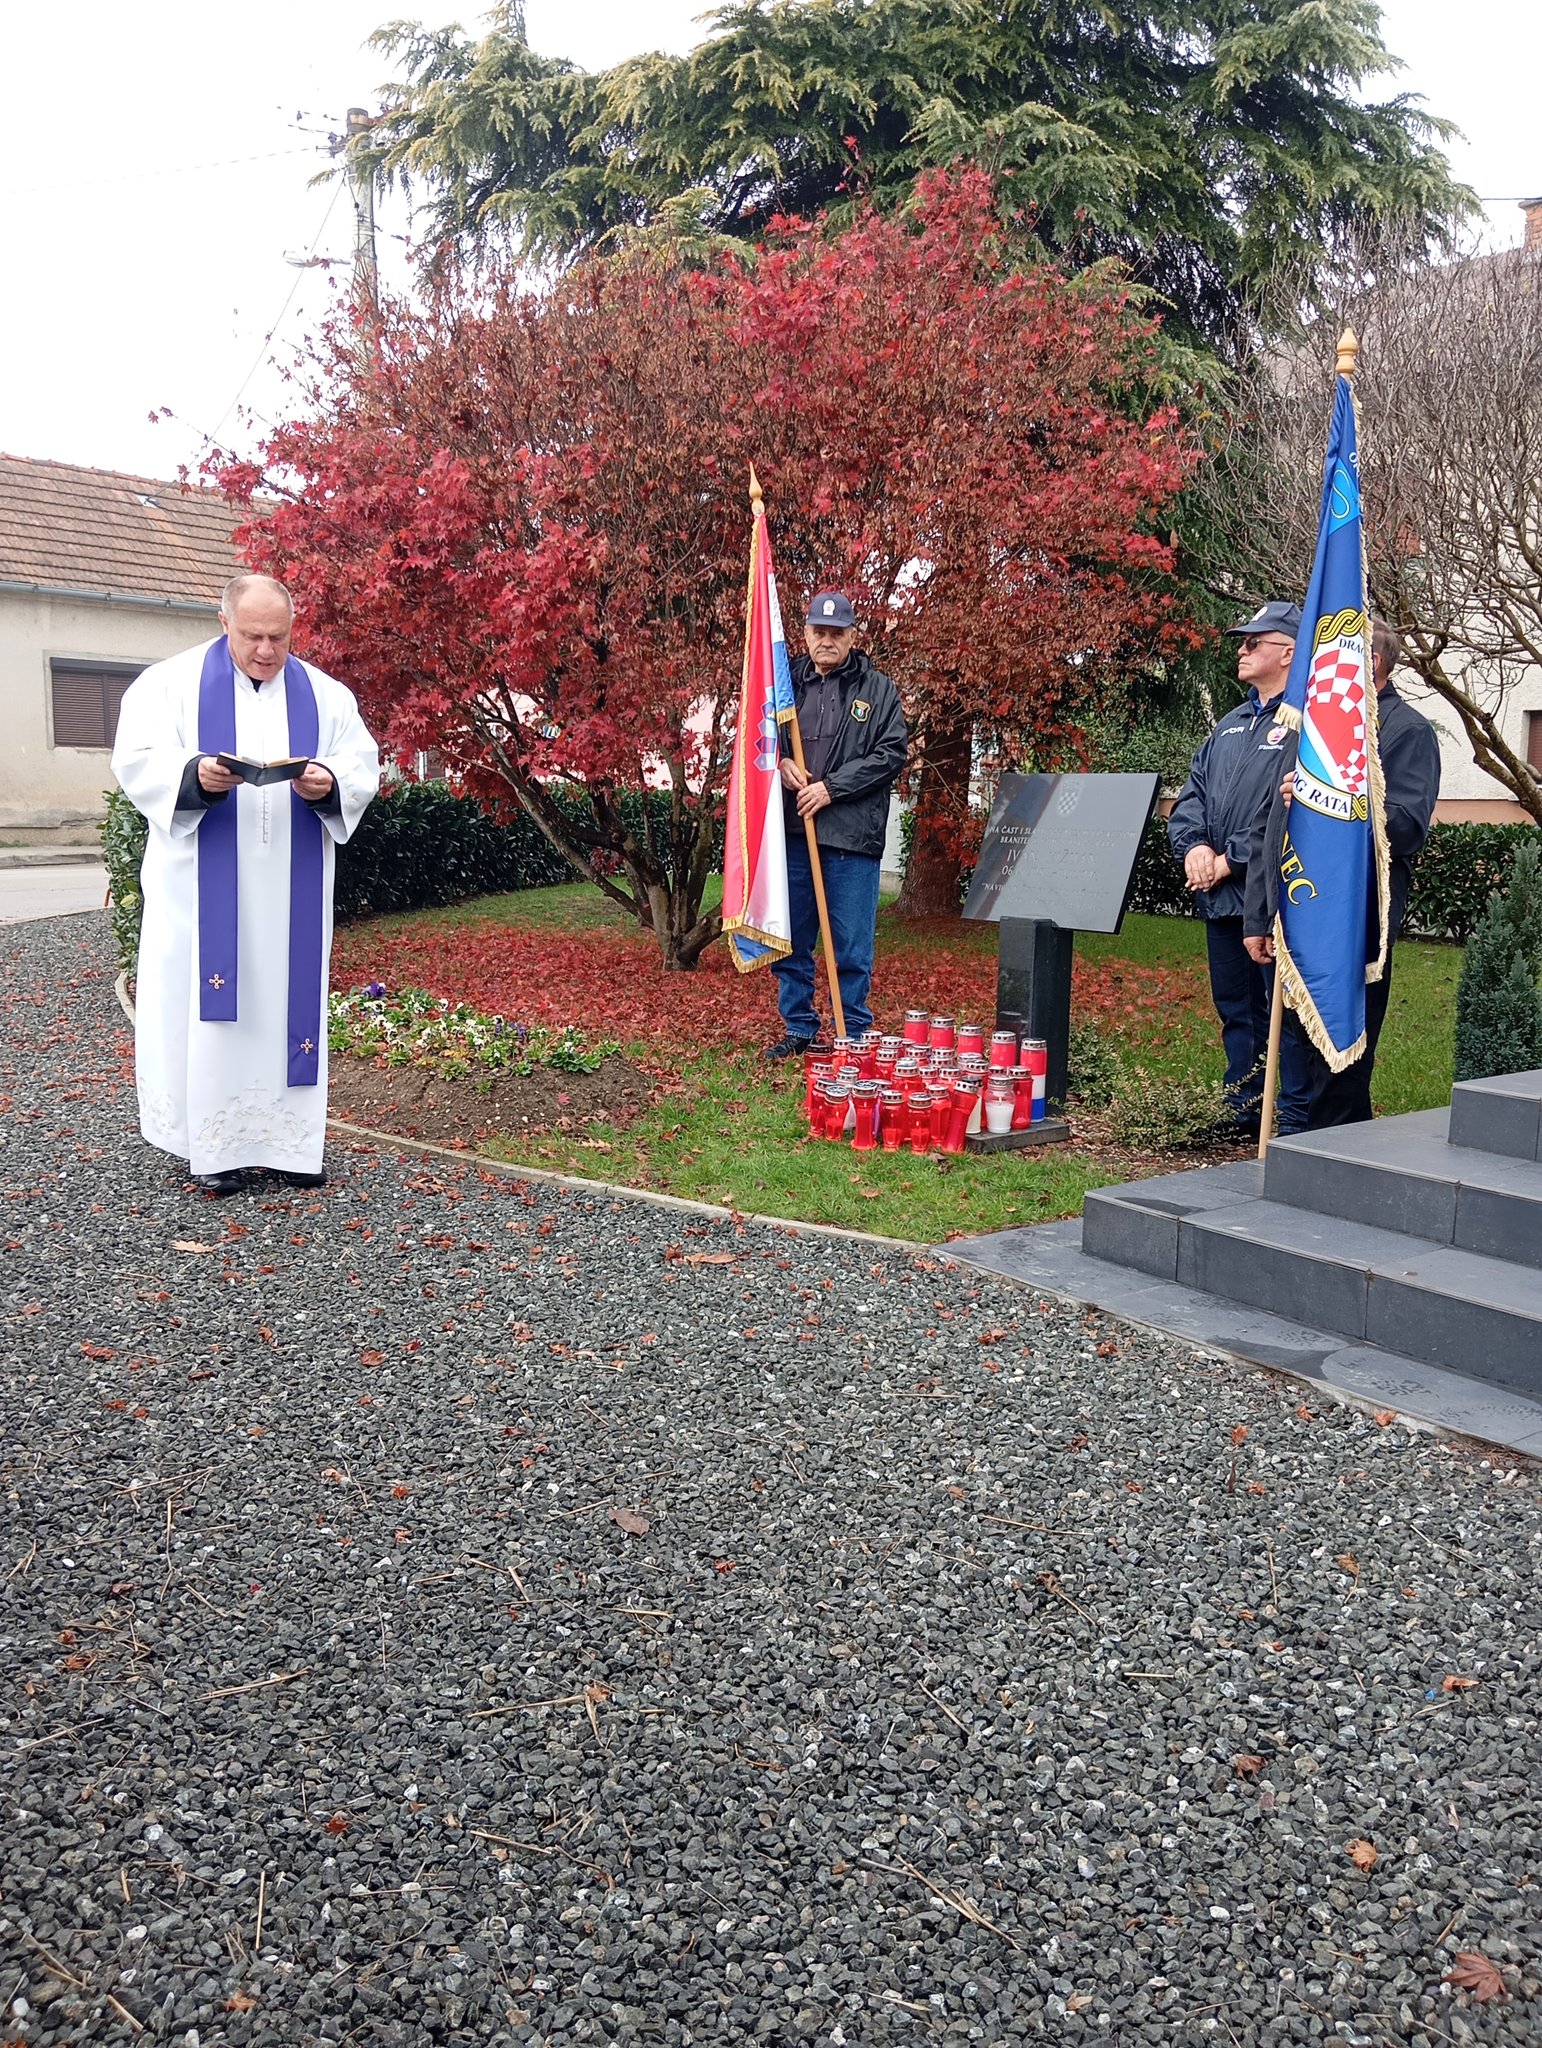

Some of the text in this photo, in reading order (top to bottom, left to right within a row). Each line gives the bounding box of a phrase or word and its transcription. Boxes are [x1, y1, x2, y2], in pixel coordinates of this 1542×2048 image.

[1308, 788, 1349, 814] RATA
[989, 826, 999, 834] NA
[1001, 825, 1019, 834] ČAST
